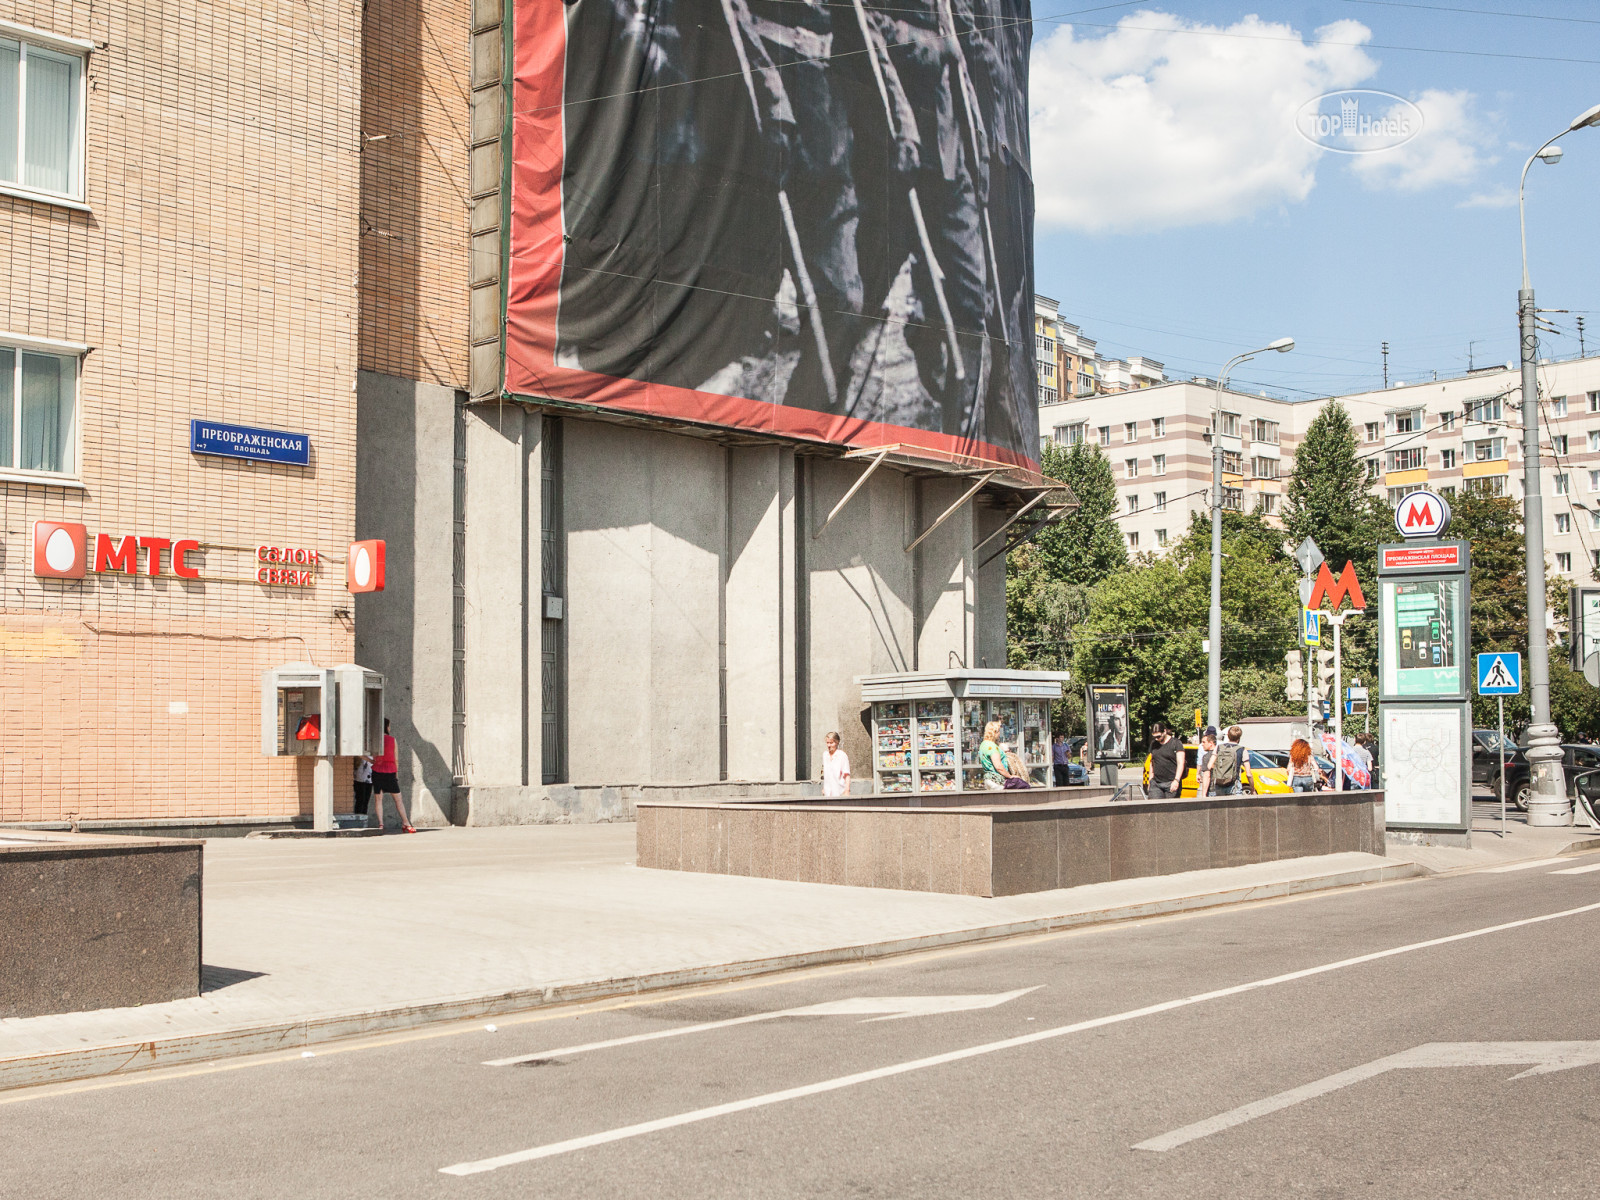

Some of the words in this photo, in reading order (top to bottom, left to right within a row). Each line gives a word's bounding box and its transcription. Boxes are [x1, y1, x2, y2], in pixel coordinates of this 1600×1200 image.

[202, 427, 302, 451] ПРЕОБРАЖЕНСКАЯ
[234, 445, 271, 455] ПЛОЩАДЬ
[92, 533, 199, 579] МТС
[1386, 554, 1431, 562] ПРЕОБРАЖЕНСКАЯ
